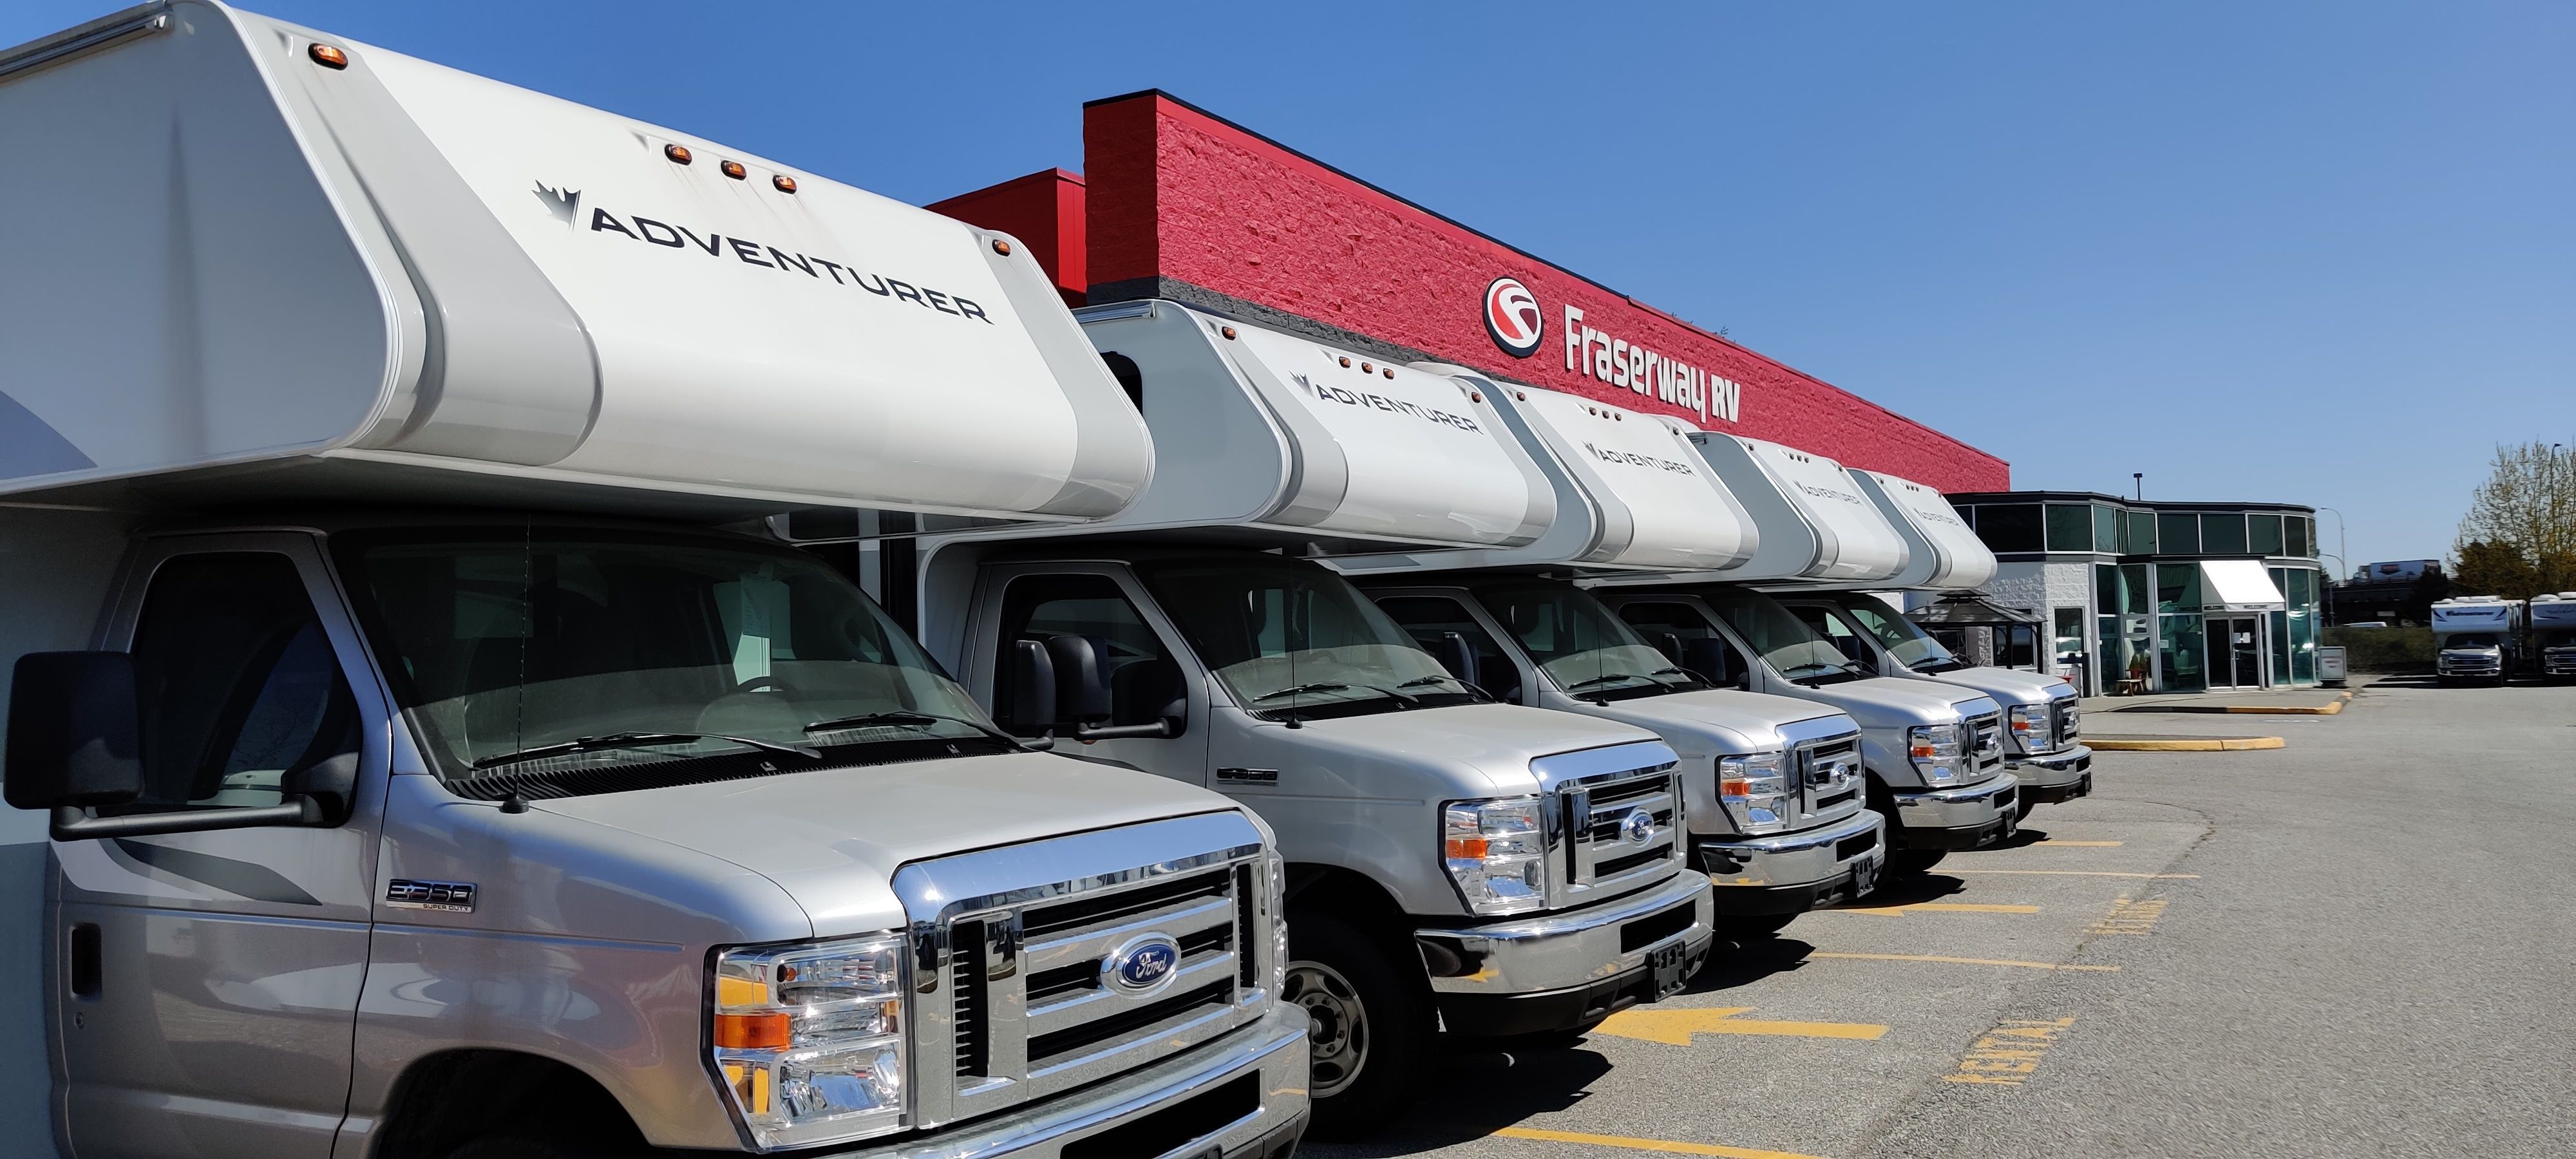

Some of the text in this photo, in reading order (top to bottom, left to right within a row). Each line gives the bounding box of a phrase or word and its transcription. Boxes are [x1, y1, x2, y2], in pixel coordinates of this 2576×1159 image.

[591, 207, 996, 326] ADVENTURER
[1564, 303, 1741, 424] Fraserway RV
[1315, 384, 1484, 435] ADVENTURER
[1597, 449, 1698, 478] ADVENTURER
[1135, 949, 1167, 979] Ford
